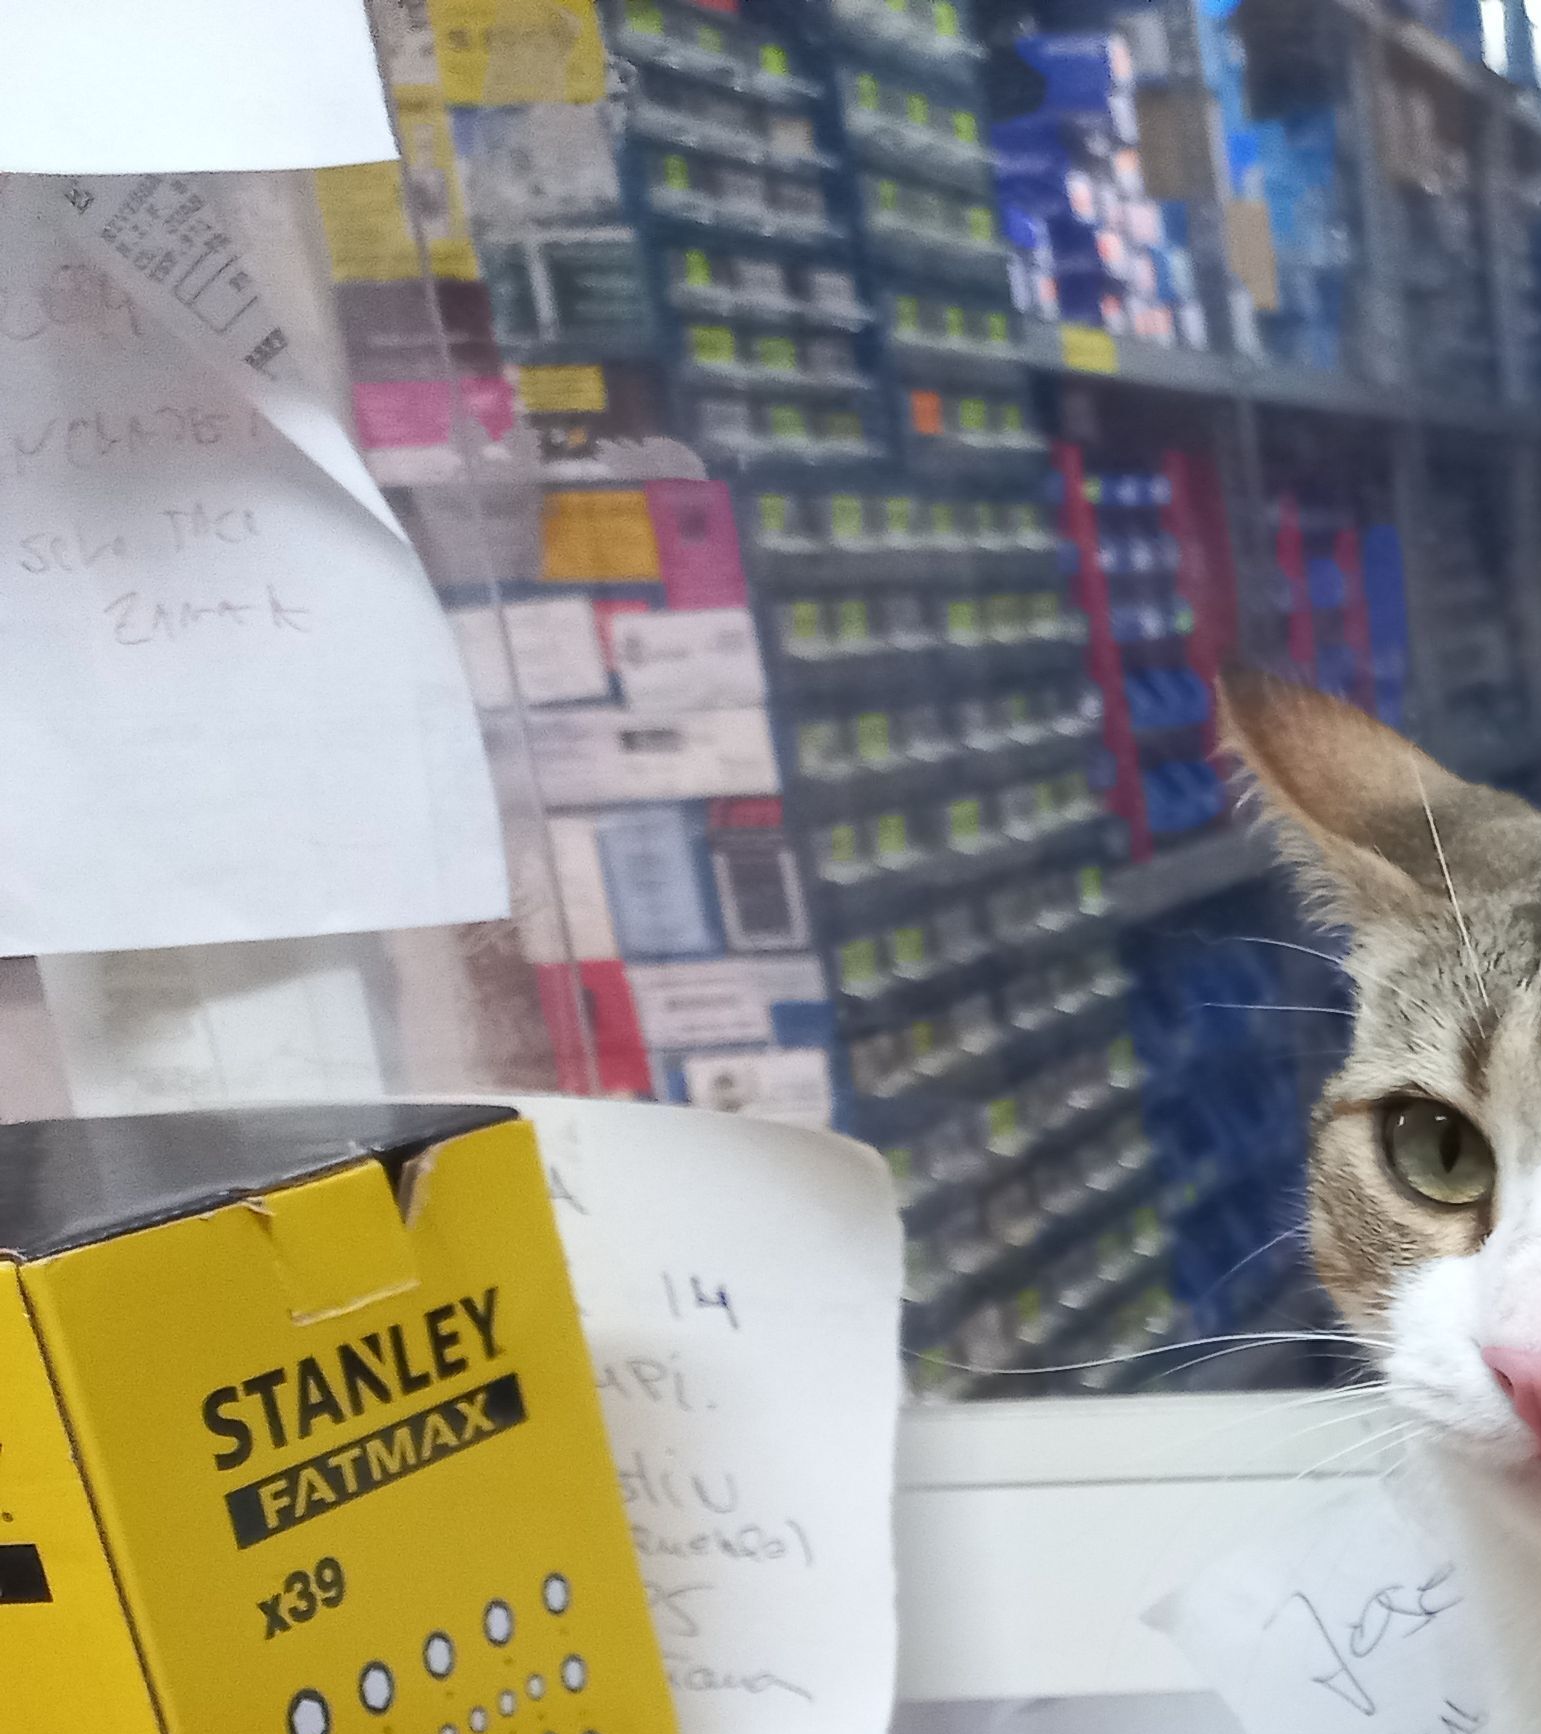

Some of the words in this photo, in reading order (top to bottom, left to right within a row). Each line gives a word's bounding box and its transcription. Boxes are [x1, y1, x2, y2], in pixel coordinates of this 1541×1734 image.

[200, 1286, 500, 1472] STANLEY
[256, 1392, 496, 1529] FATMAX
[256, 1555, 346, 1641] x39
